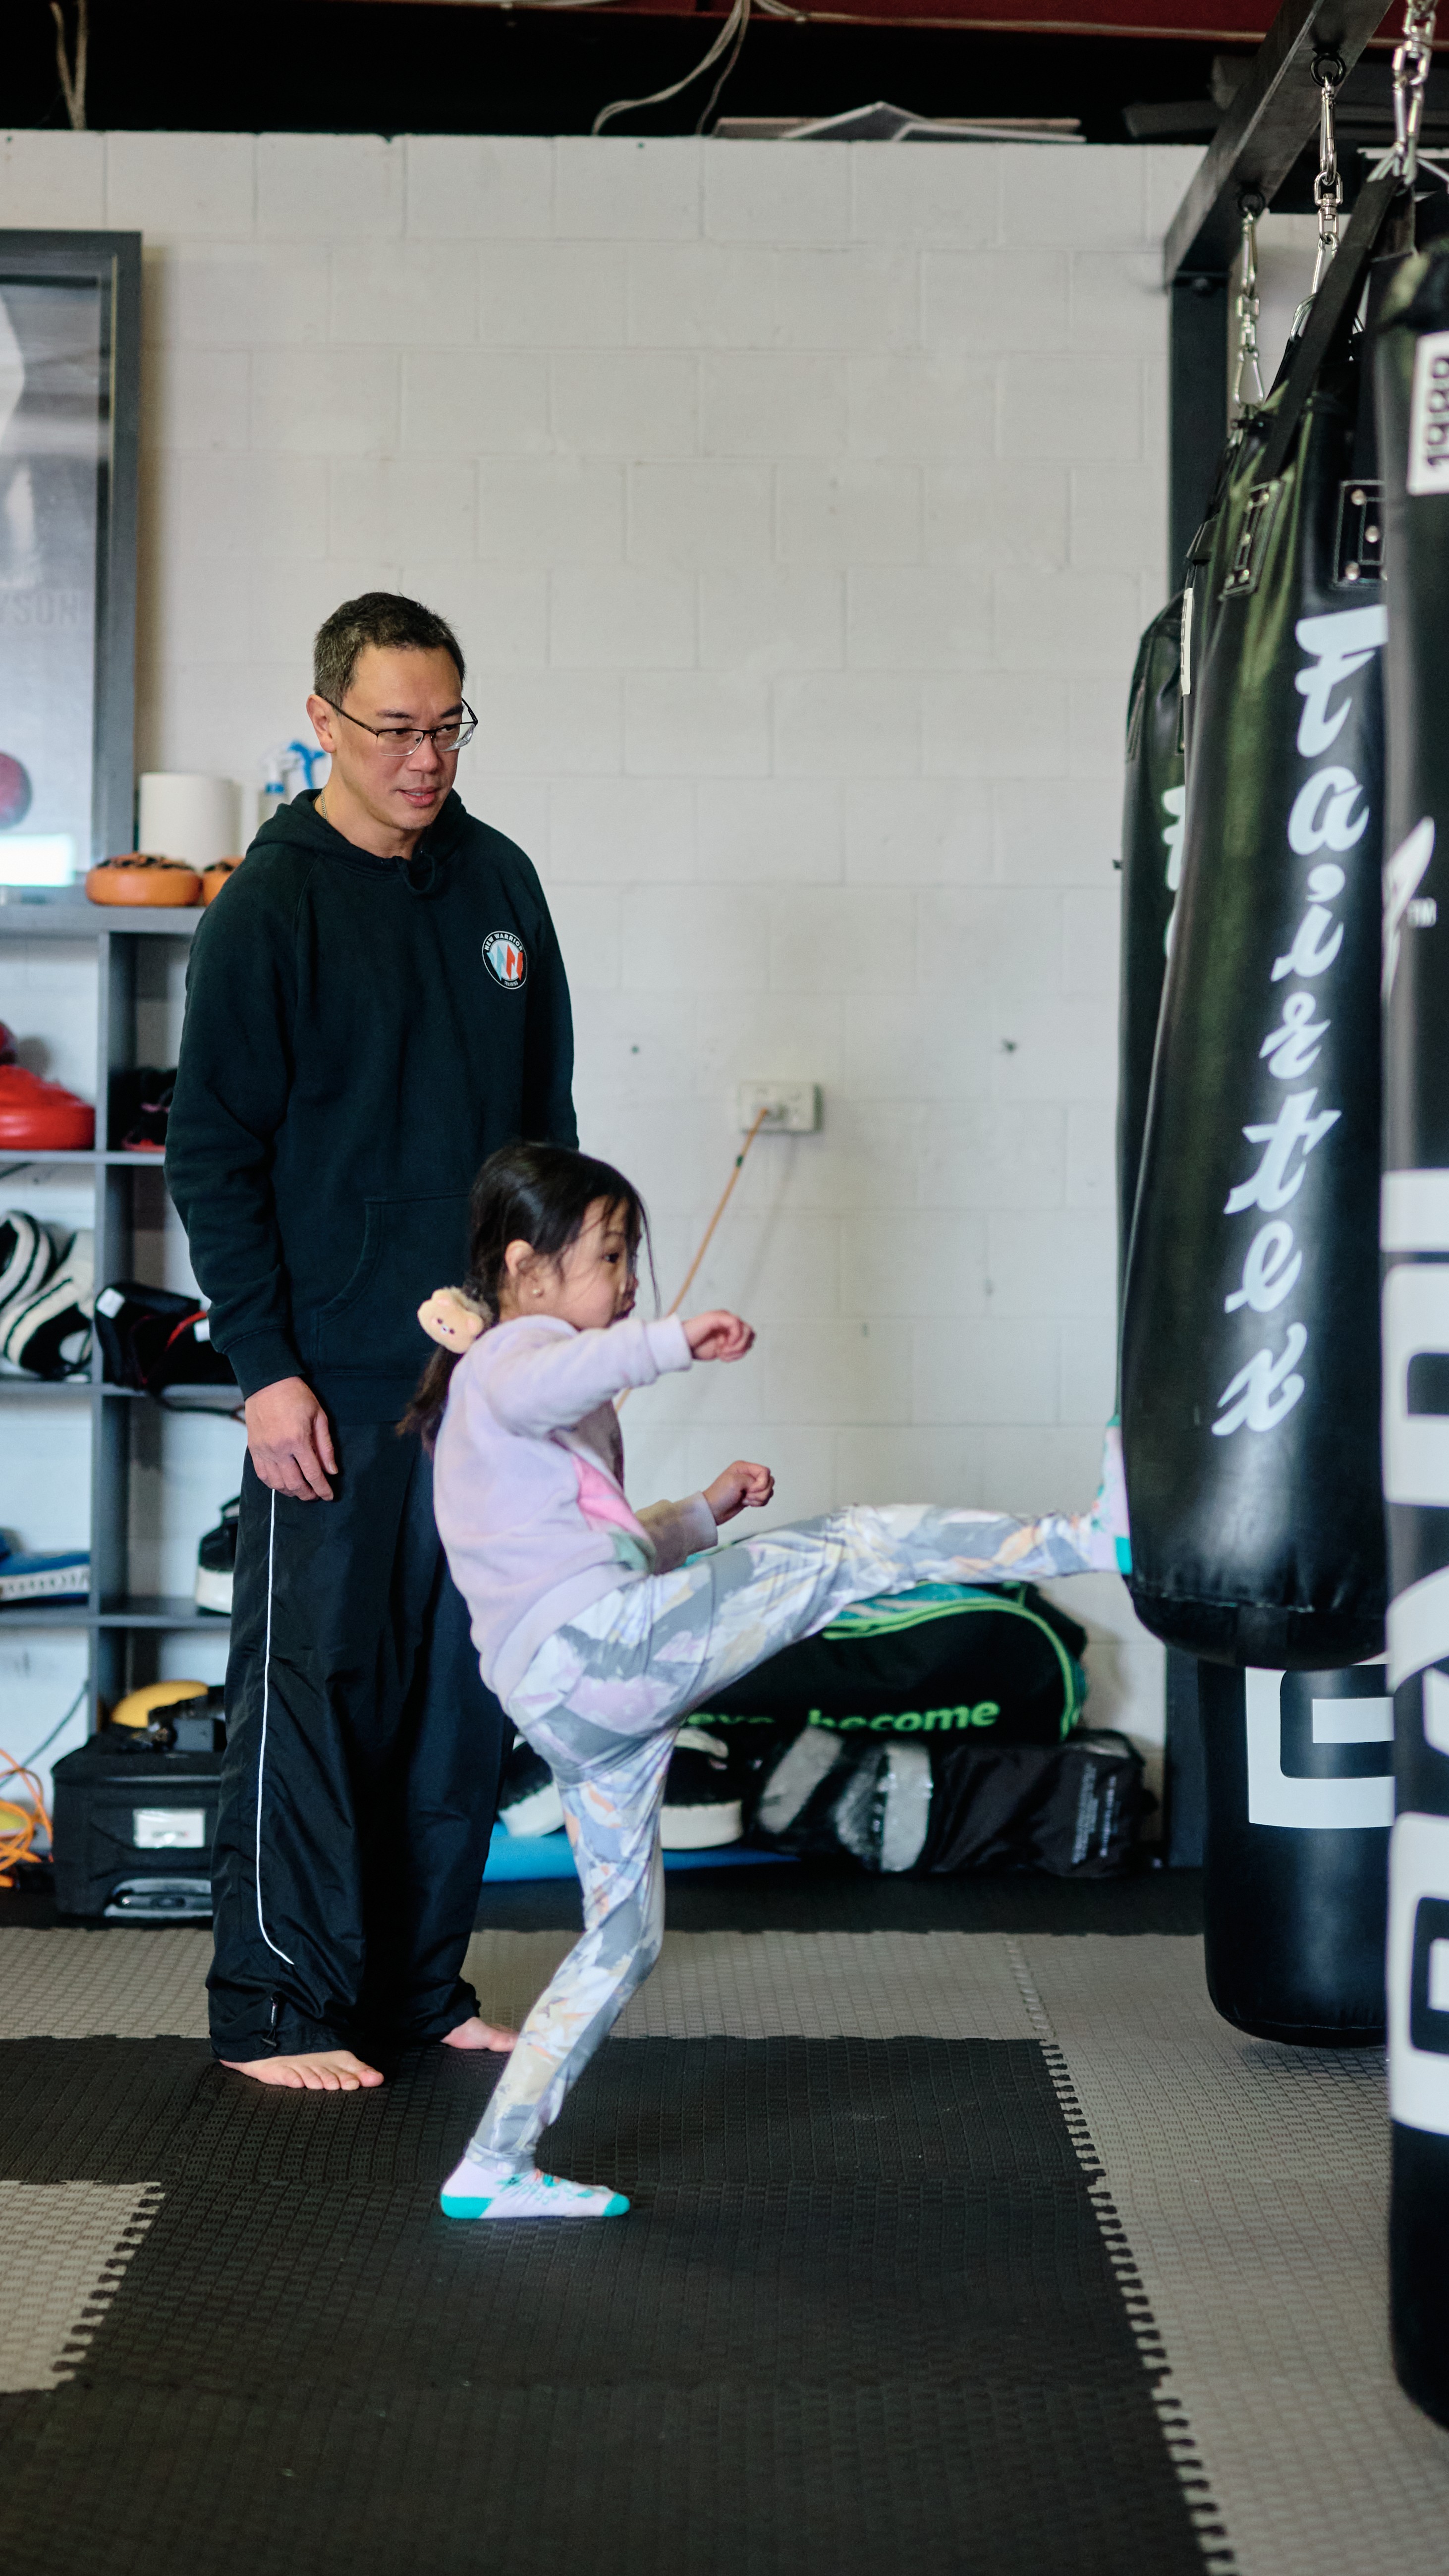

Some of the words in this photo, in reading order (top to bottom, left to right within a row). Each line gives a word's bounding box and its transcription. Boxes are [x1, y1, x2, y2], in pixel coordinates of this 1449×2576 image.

[484, 936, 494, 951] NEW
[494, 933, 523, 951] WARRIOR
[1211, 603, 1388, 1436] Fairtex
